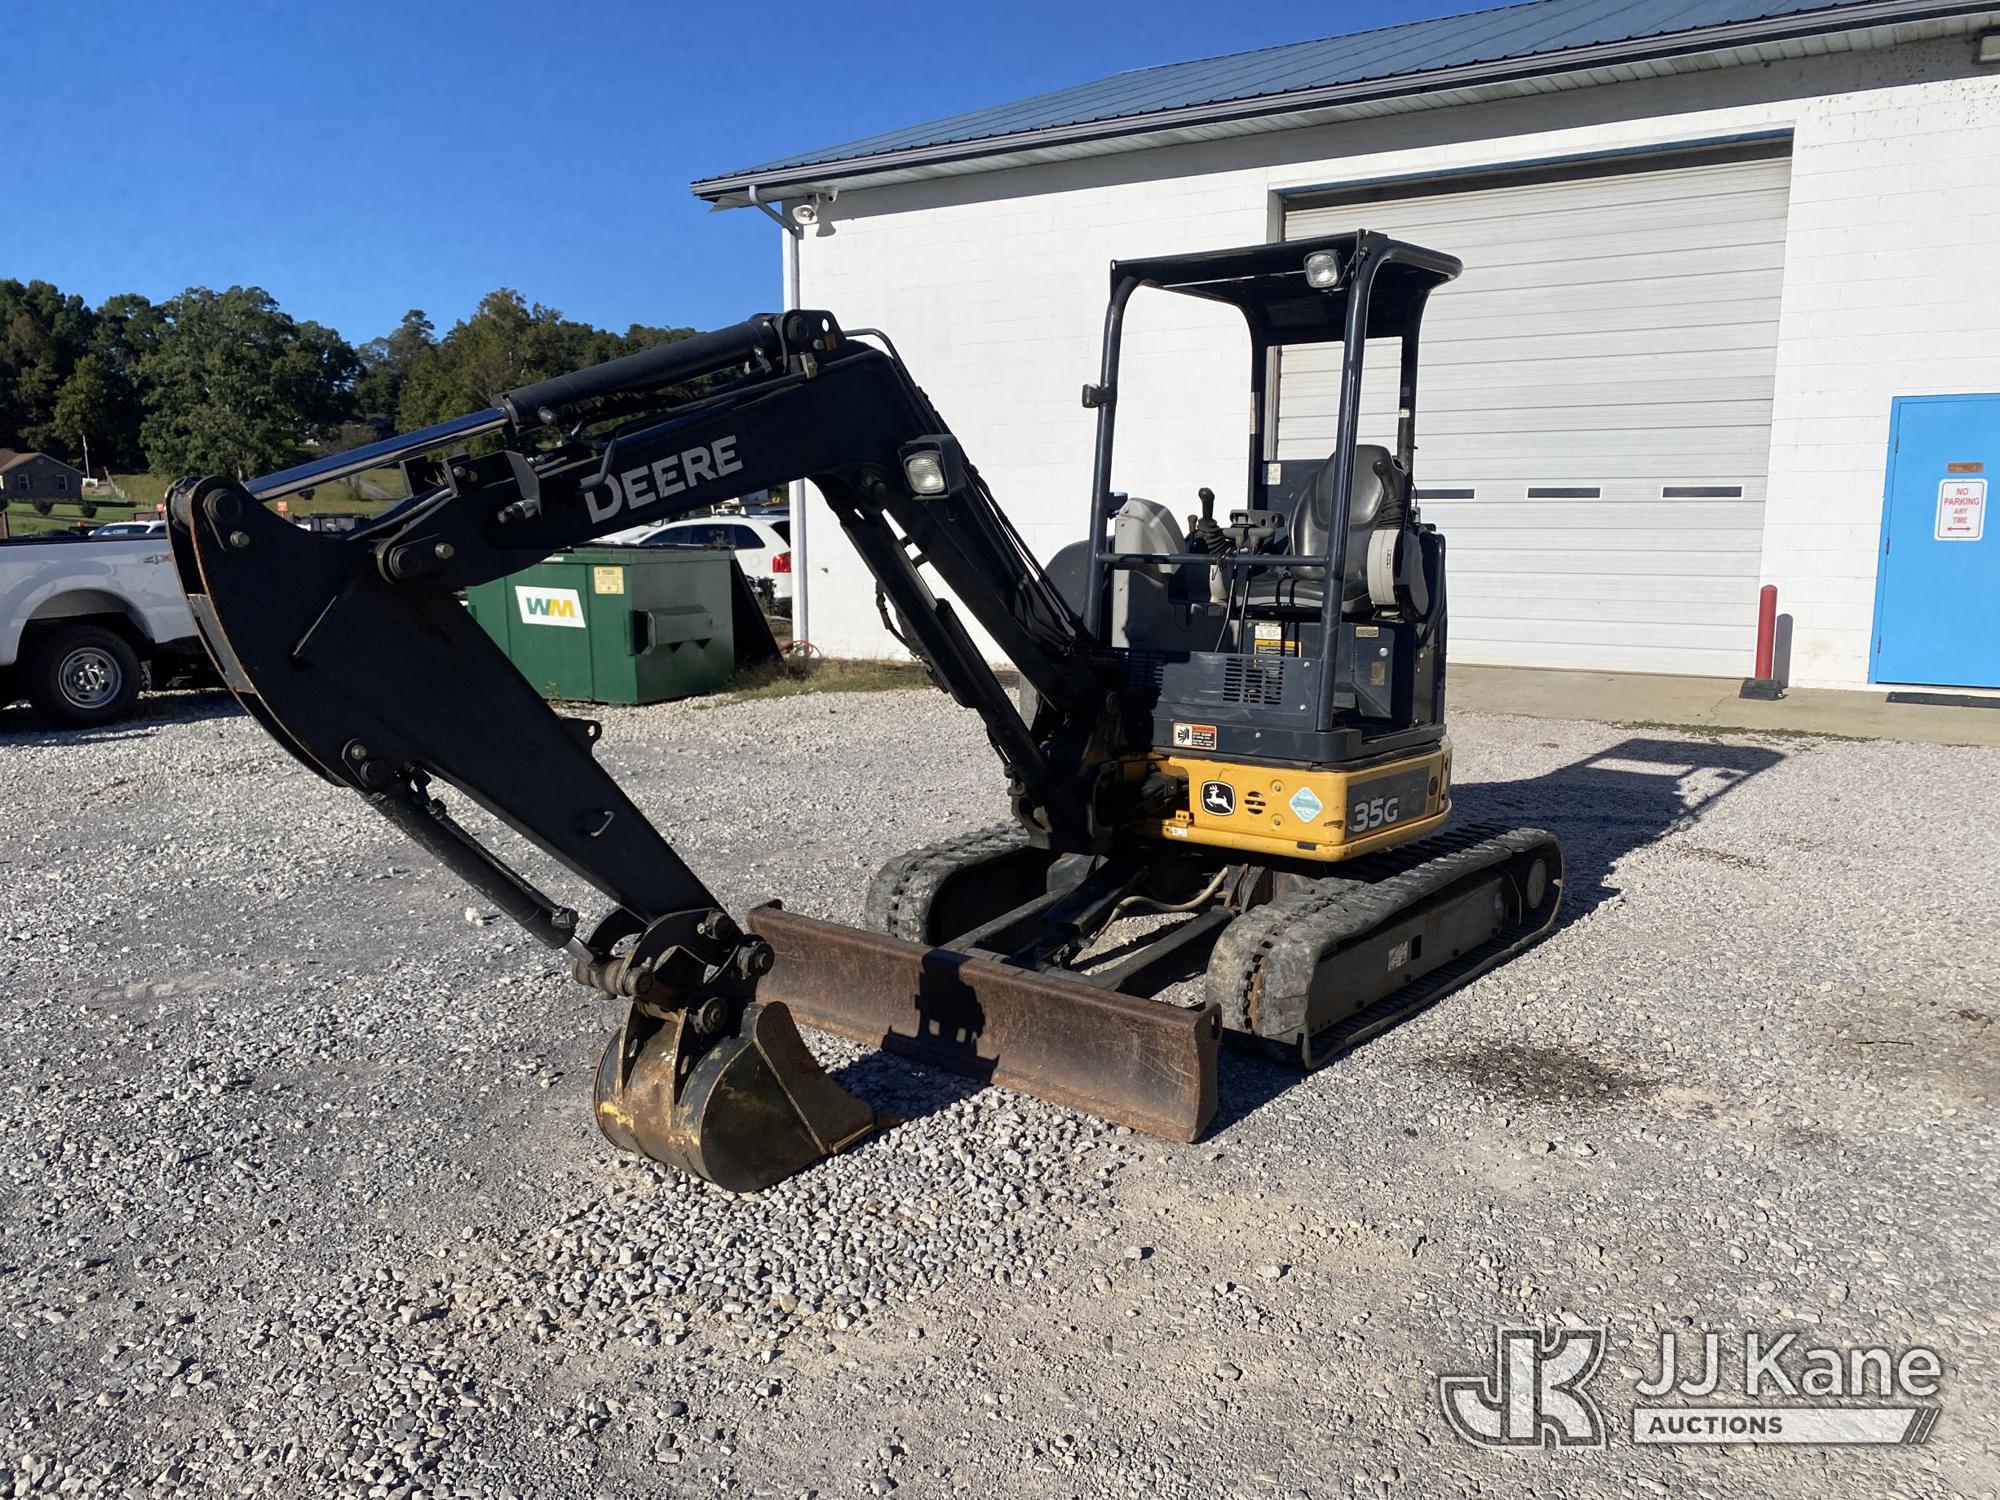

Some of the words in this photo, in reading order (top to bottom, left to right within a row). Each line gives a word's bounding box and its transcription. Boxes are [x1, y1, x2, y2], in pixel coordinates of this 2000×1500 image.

[579, 434, 743, 524] DEERE
[1956, 487, 1969, 496] NO
[1943, 497, 1980, 506] PARKING
[1952, 516, 1969, 524] TIME
[526, 597, 576, 618] WM
[1349, 797, 1399, 832] 35G
